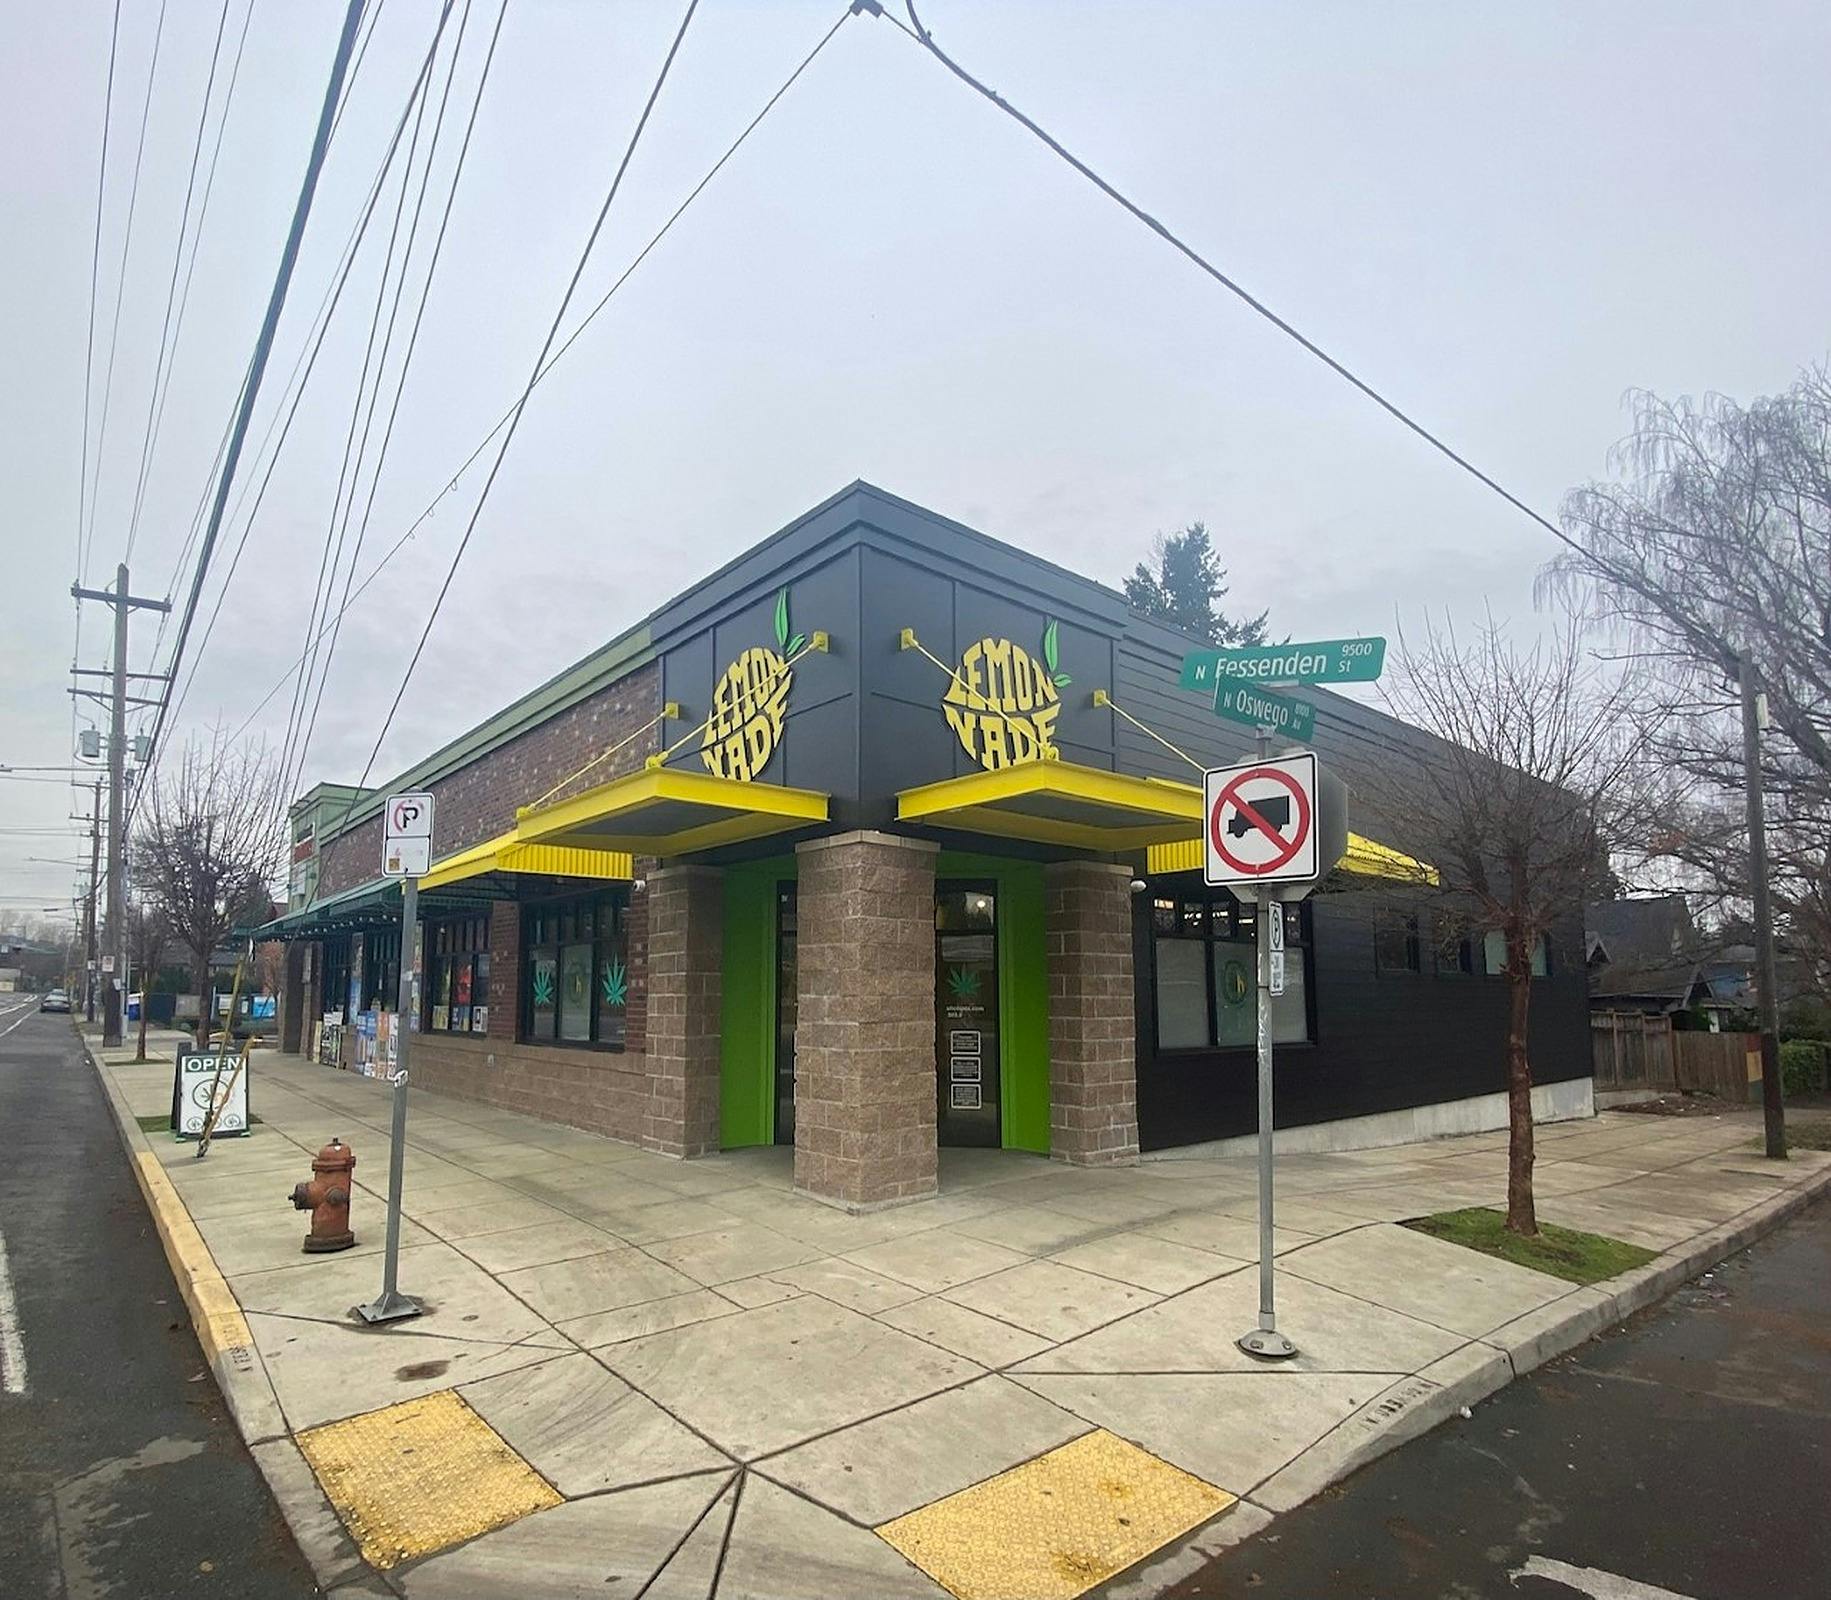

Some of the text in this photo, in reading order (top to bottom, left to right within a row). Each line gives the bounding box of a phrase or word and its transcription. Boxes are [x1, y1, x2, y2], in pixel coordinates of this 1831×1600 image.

[943, 638, 1059, 712] LEMON
[1194, 651, 1351, 681] N Fessenden St
[1342, 643, 1372, 656] 9500
[701, 647, 790, 748] LEMON
[1224, 690, 1289, 728] N Oswego
[700, 671, 793, 782] NADE
[942, 703, 1061, 771] NADE
[187, 1057, 241, 1071] OPEN
